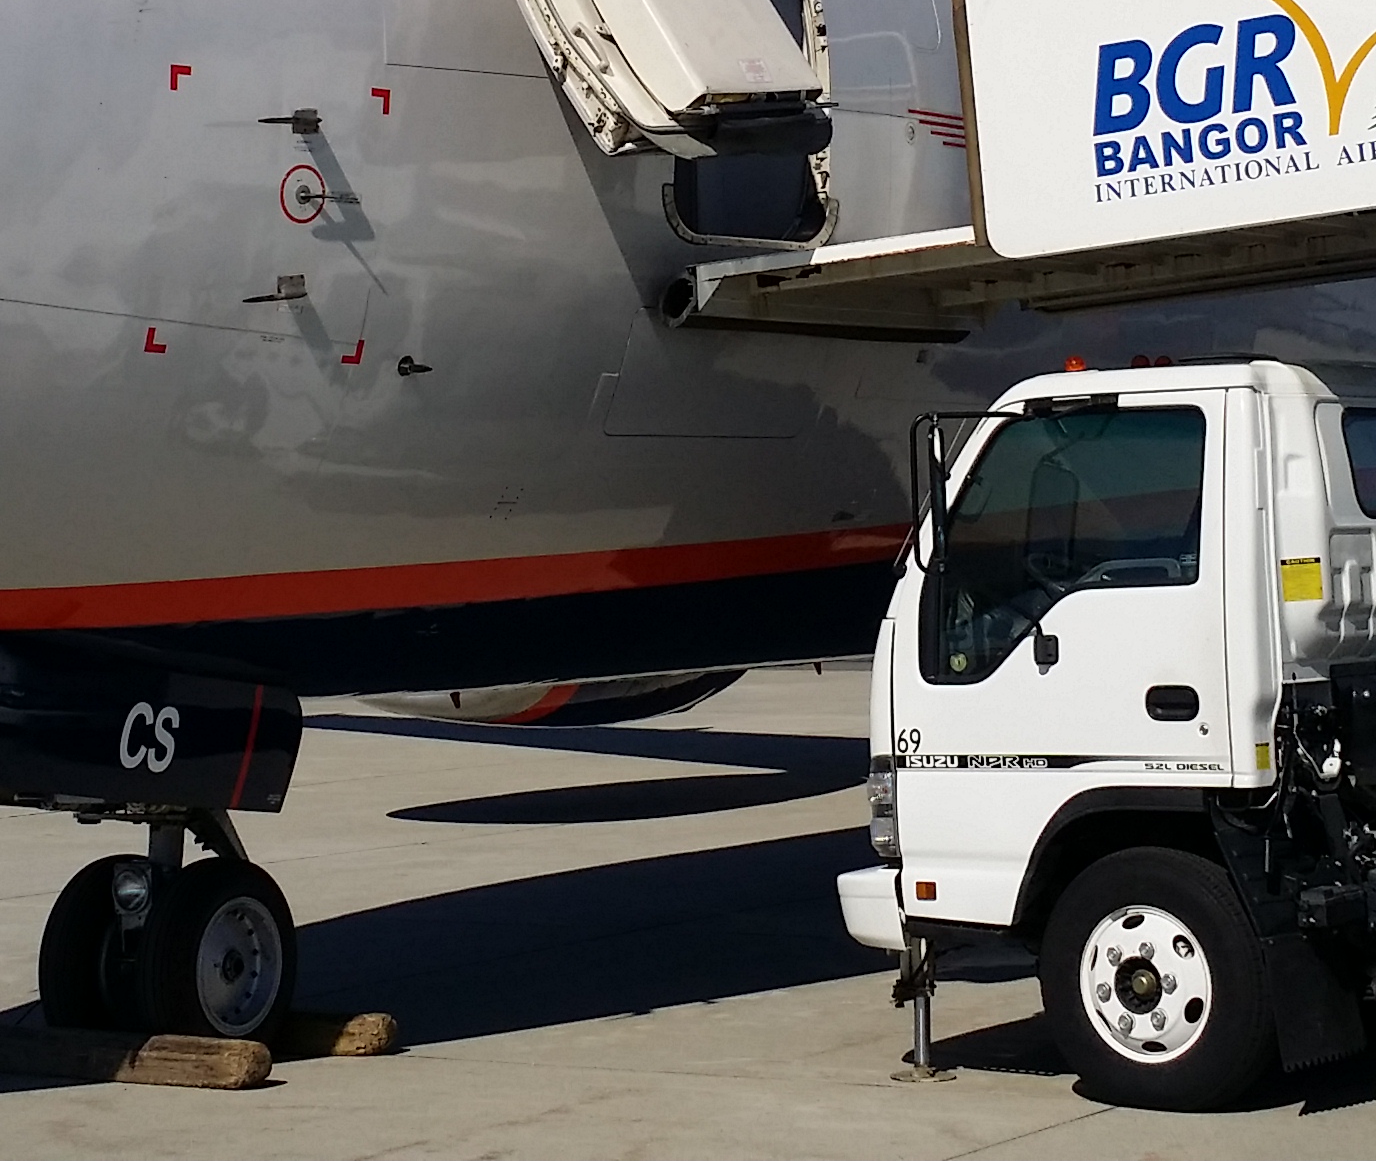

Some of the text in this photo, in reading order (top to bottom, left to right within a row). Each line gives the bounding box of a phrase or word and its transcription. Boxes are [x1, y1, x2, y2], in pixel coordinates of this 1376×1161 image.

[1092, 13, 1297, 137] BGR
[1094, 111, 1308, 178] BANGOR
[1095, 152, 1320, 203] INTERNATIONAL
[119, 701, 180, 773] CS
[897, 728, 921, 754] 69
[905, 755, 959, 768] ISUZU
[967, 755, 1020, 769] NPR
[1023, 758, 1048, 769] HD
[1176, 763, 1225, 771] DIESEL
